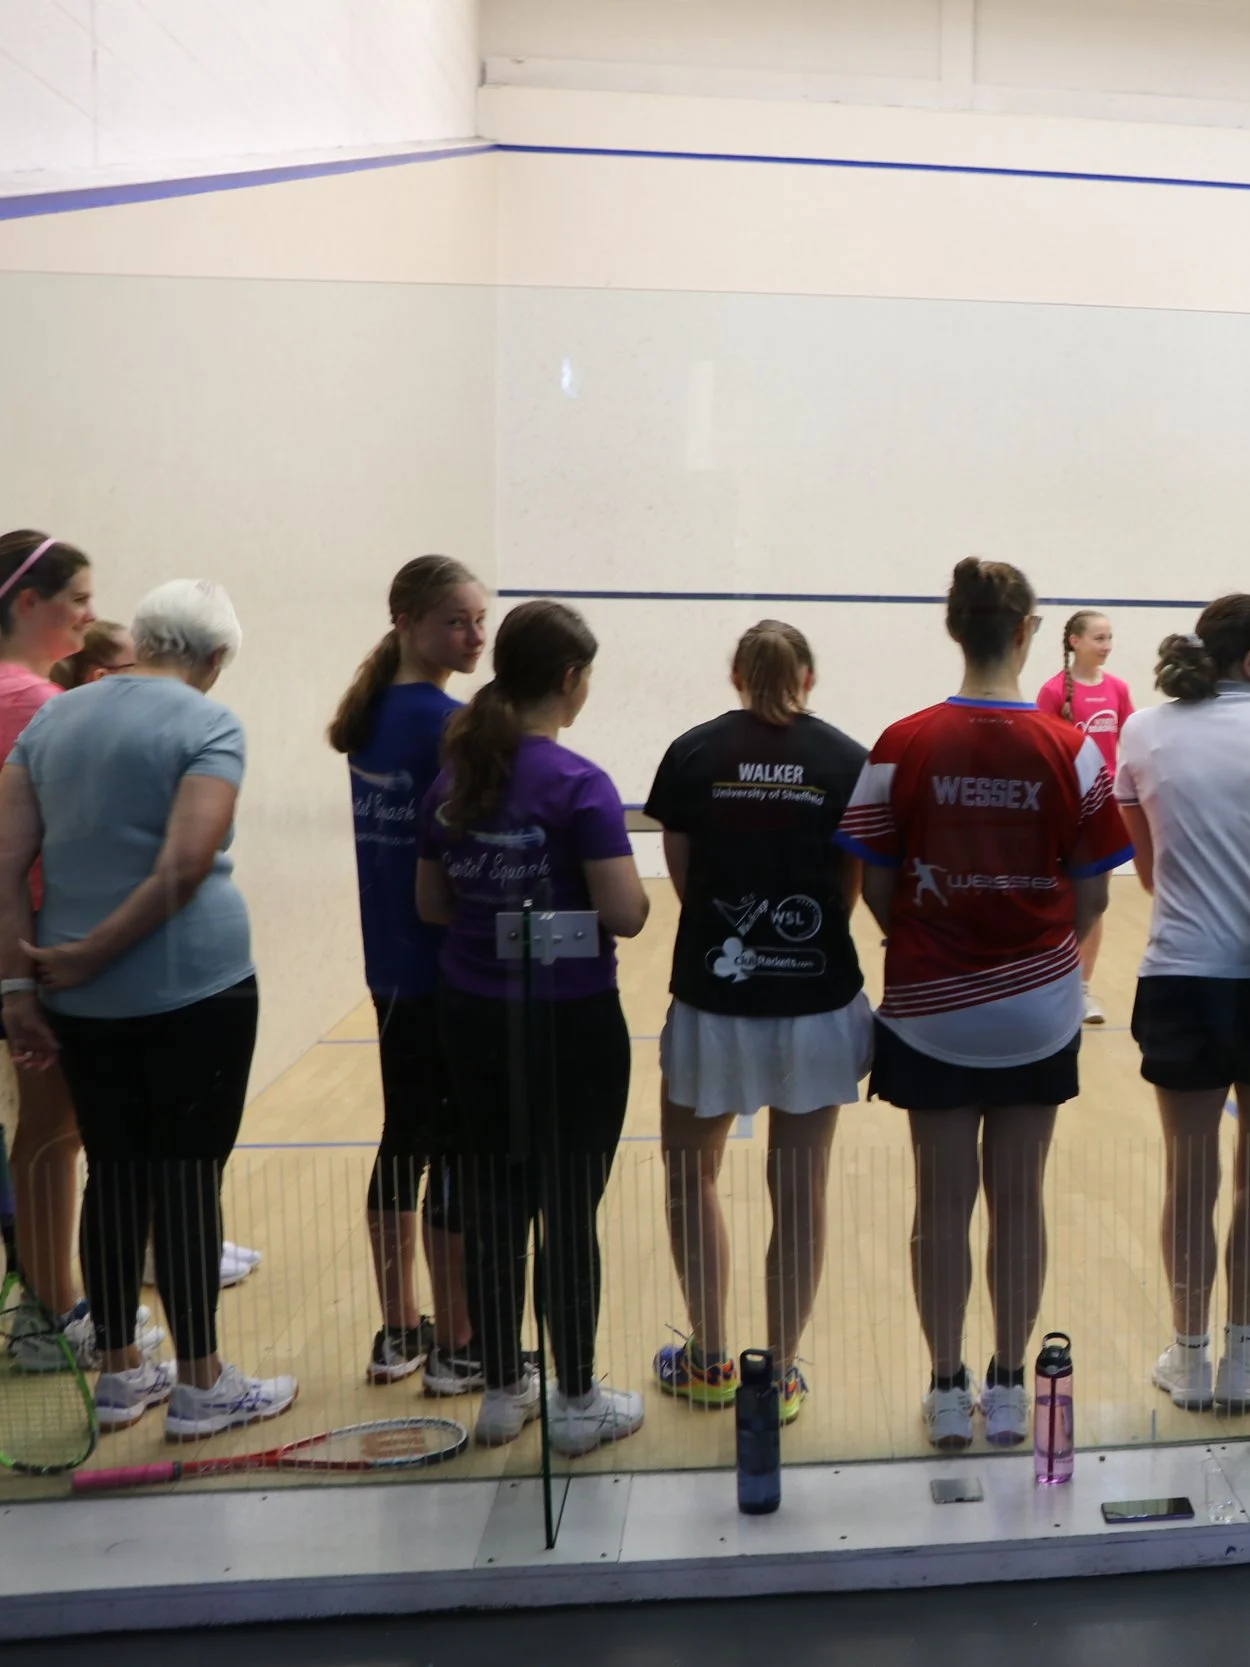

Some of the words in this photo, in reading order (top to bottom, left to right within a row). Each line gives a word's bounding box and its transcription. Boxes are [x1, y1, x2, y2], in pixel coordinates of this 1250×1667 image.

[738, 762, 805, 784] WALKER
[712, 787, 767, 801] University
[768, 788, 780, 799] of
[932, 776, 1043, 811] WESSEX
[771, 910, 805, 926] WSL
